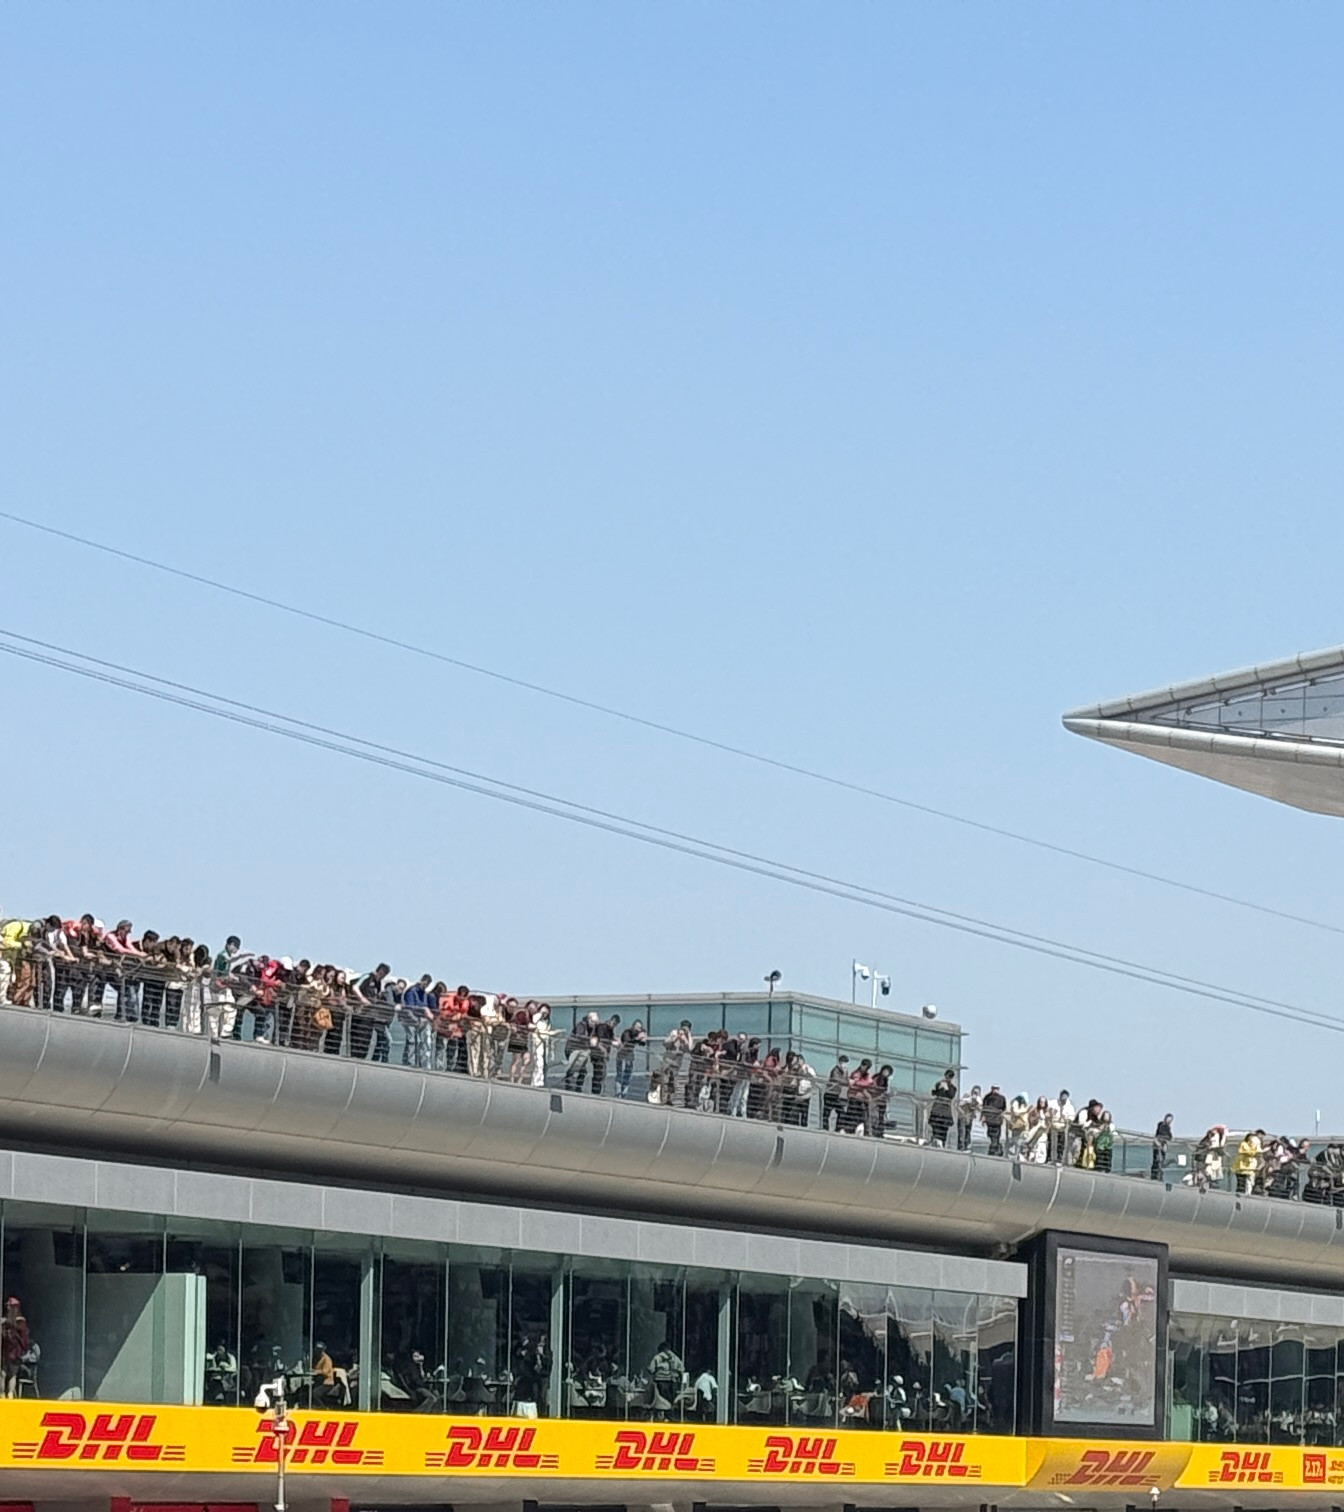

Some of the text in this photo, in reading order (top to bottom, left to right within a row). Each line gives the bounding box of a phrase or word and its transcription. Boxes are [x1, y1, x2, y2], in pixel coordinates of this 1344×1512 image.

[36, 1411, 164, 1461] DHL
[254, 1419, 365, 1466] DHL
[444, 1425, 543, 1468] DHL
[611, 1430, 701, 1472] DHL
[762, 1435, 843, 1475] DHL
[898, 1440, 967, 1478] DHL
[1066, 1449, 1157, 1486] DHL
[1218, 1451, 1273, 1483] DHL
